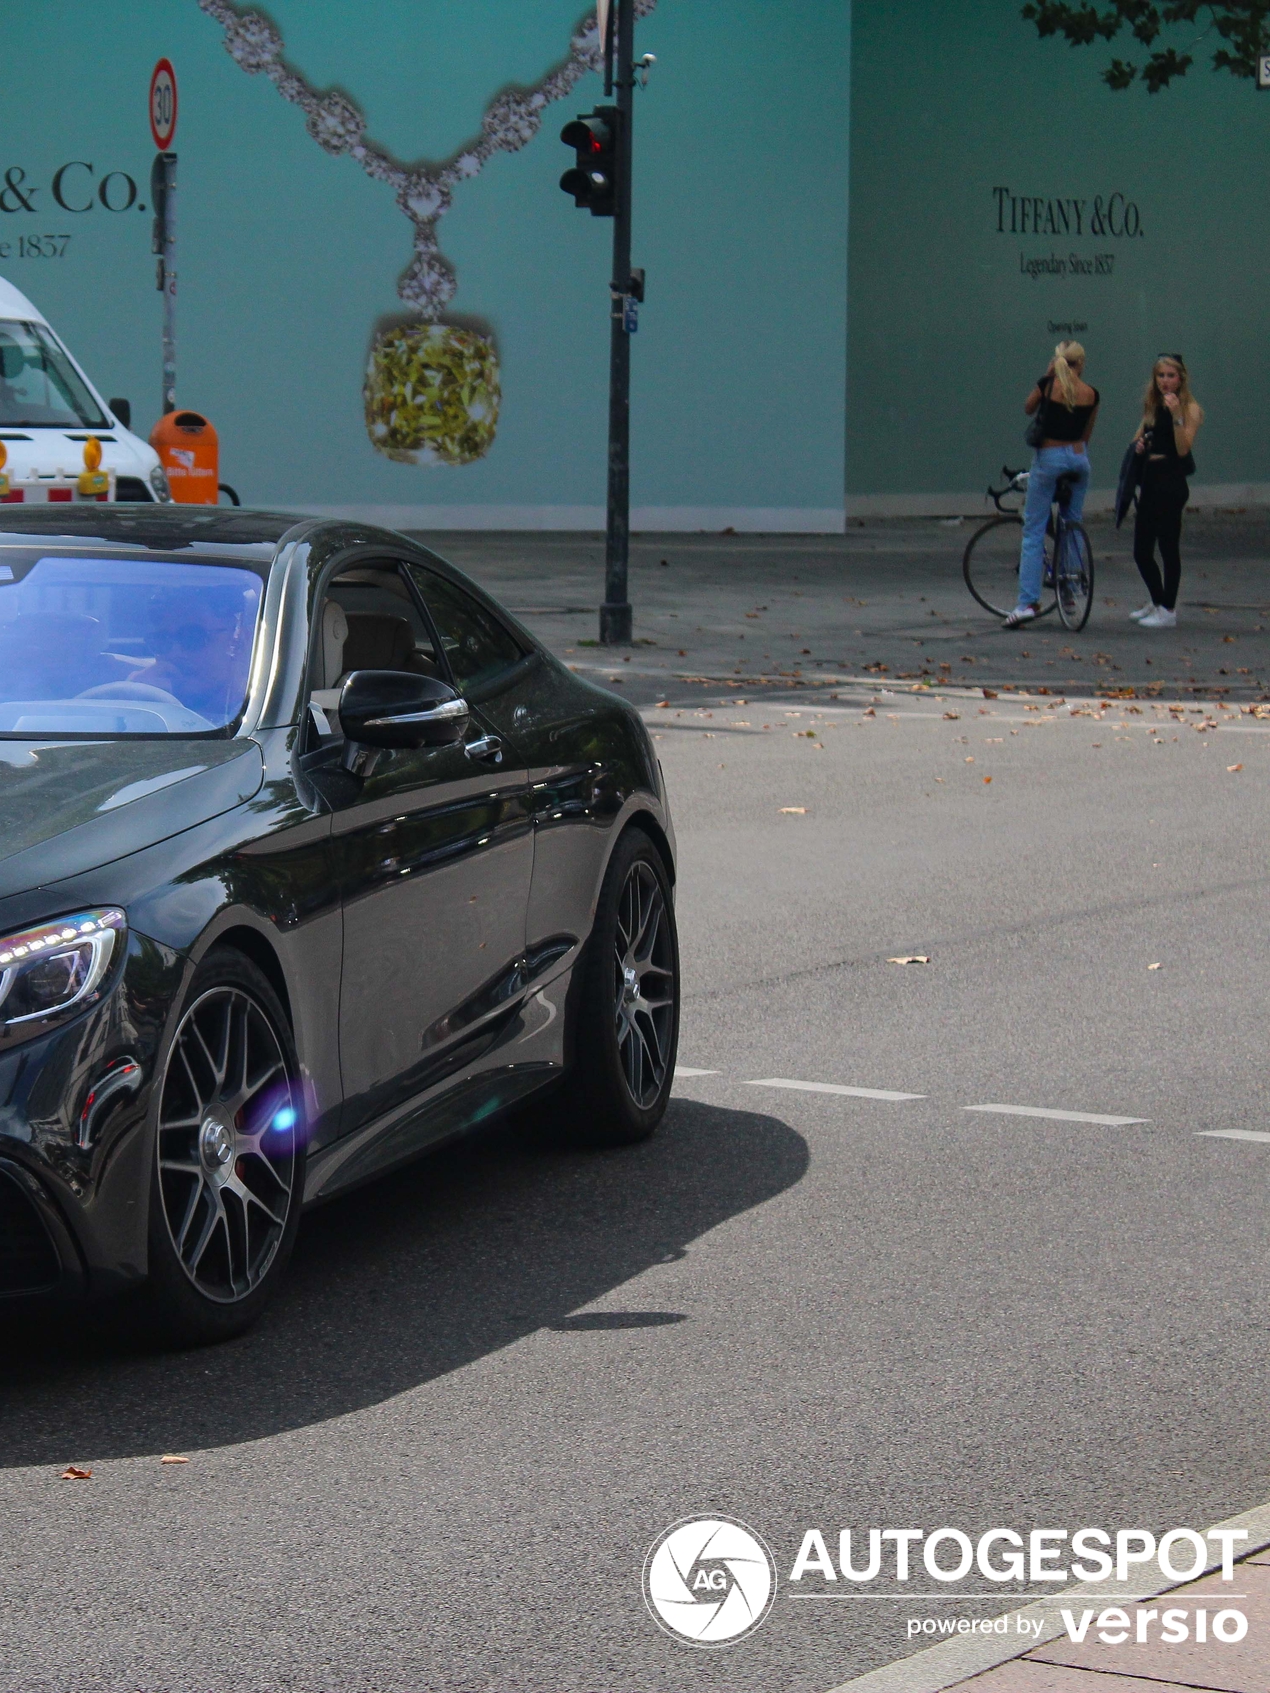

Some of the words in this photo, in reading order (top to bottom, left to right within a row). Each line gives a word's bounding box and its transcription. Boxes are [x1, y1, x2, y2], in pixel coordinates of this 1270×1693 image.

[154, 84, 171, 126] 30
[52, 161, 146, 213] Co.
[993, 186, 1085, 235] TIFFANY
[18, 234, 72, 258] 1837
[1020, 252, 1067, 280] Legendary
[1068, 252, 1093, 274] Since
